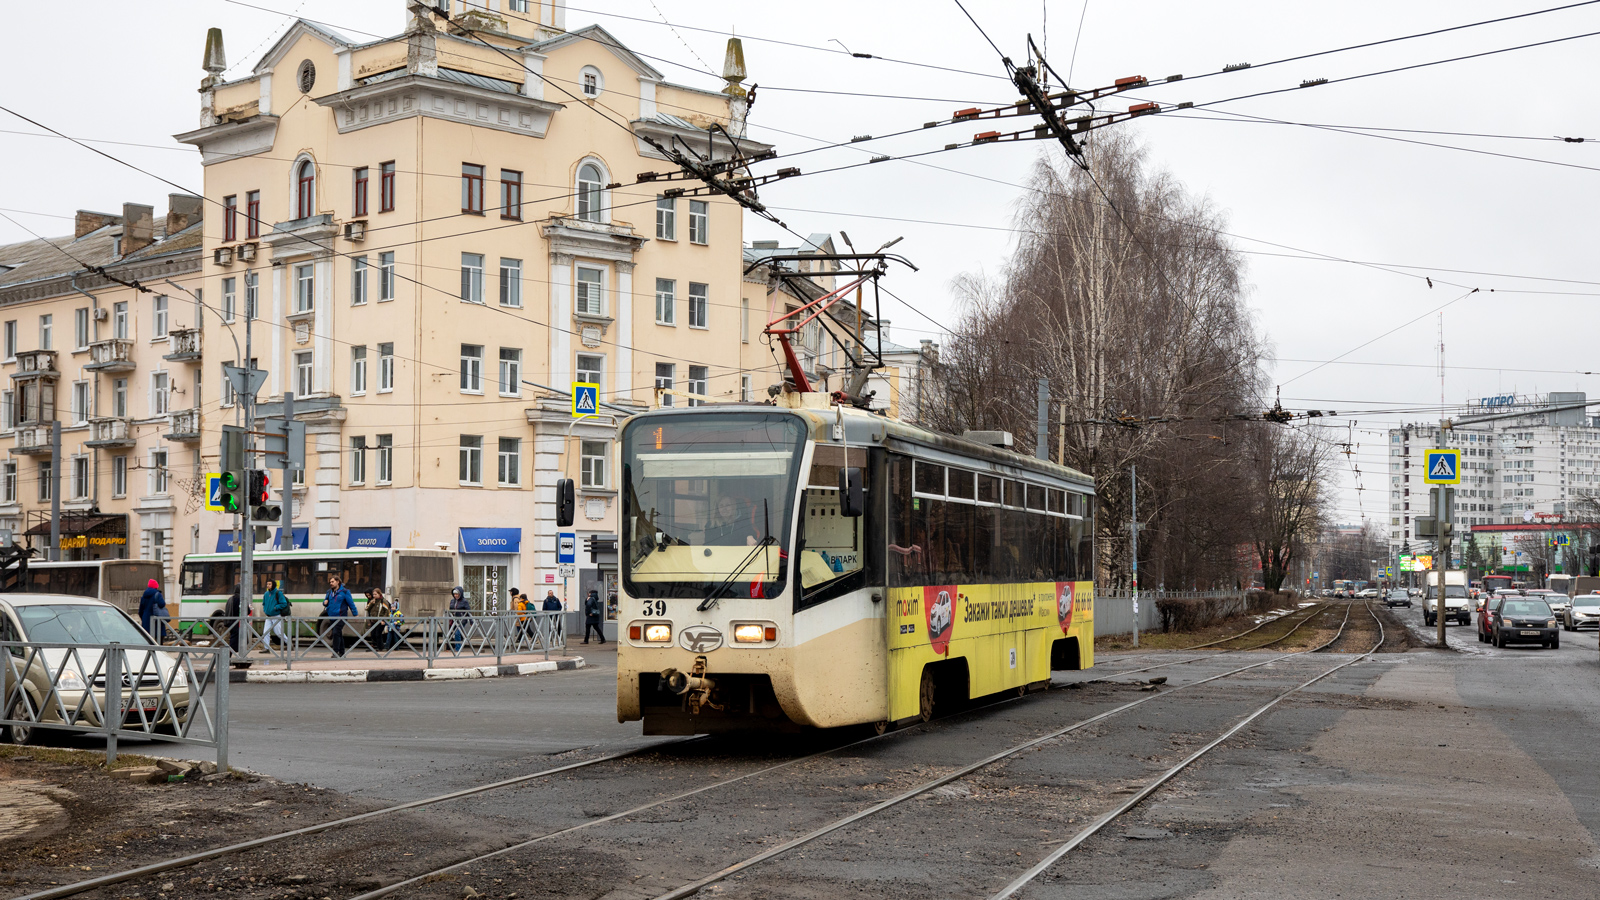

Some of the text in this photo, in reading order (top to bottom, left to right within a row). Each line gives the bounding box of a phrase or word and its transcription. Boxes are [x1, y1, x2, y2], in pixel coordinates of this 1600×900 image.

[1480, 395, 1514, 408] ГИПРО
[652, 427, 662, 450] 1
[59, 537, 88, 550] ДАРКИ
[89, 537, 127, 546] ПОДАРКИ
[642, 599, 667, 617] 39
[964, 596, 990, 623] Закажи
[990, 601, 1009, 620] такси
[1075, 592, 1093, 612] 66 66 66
